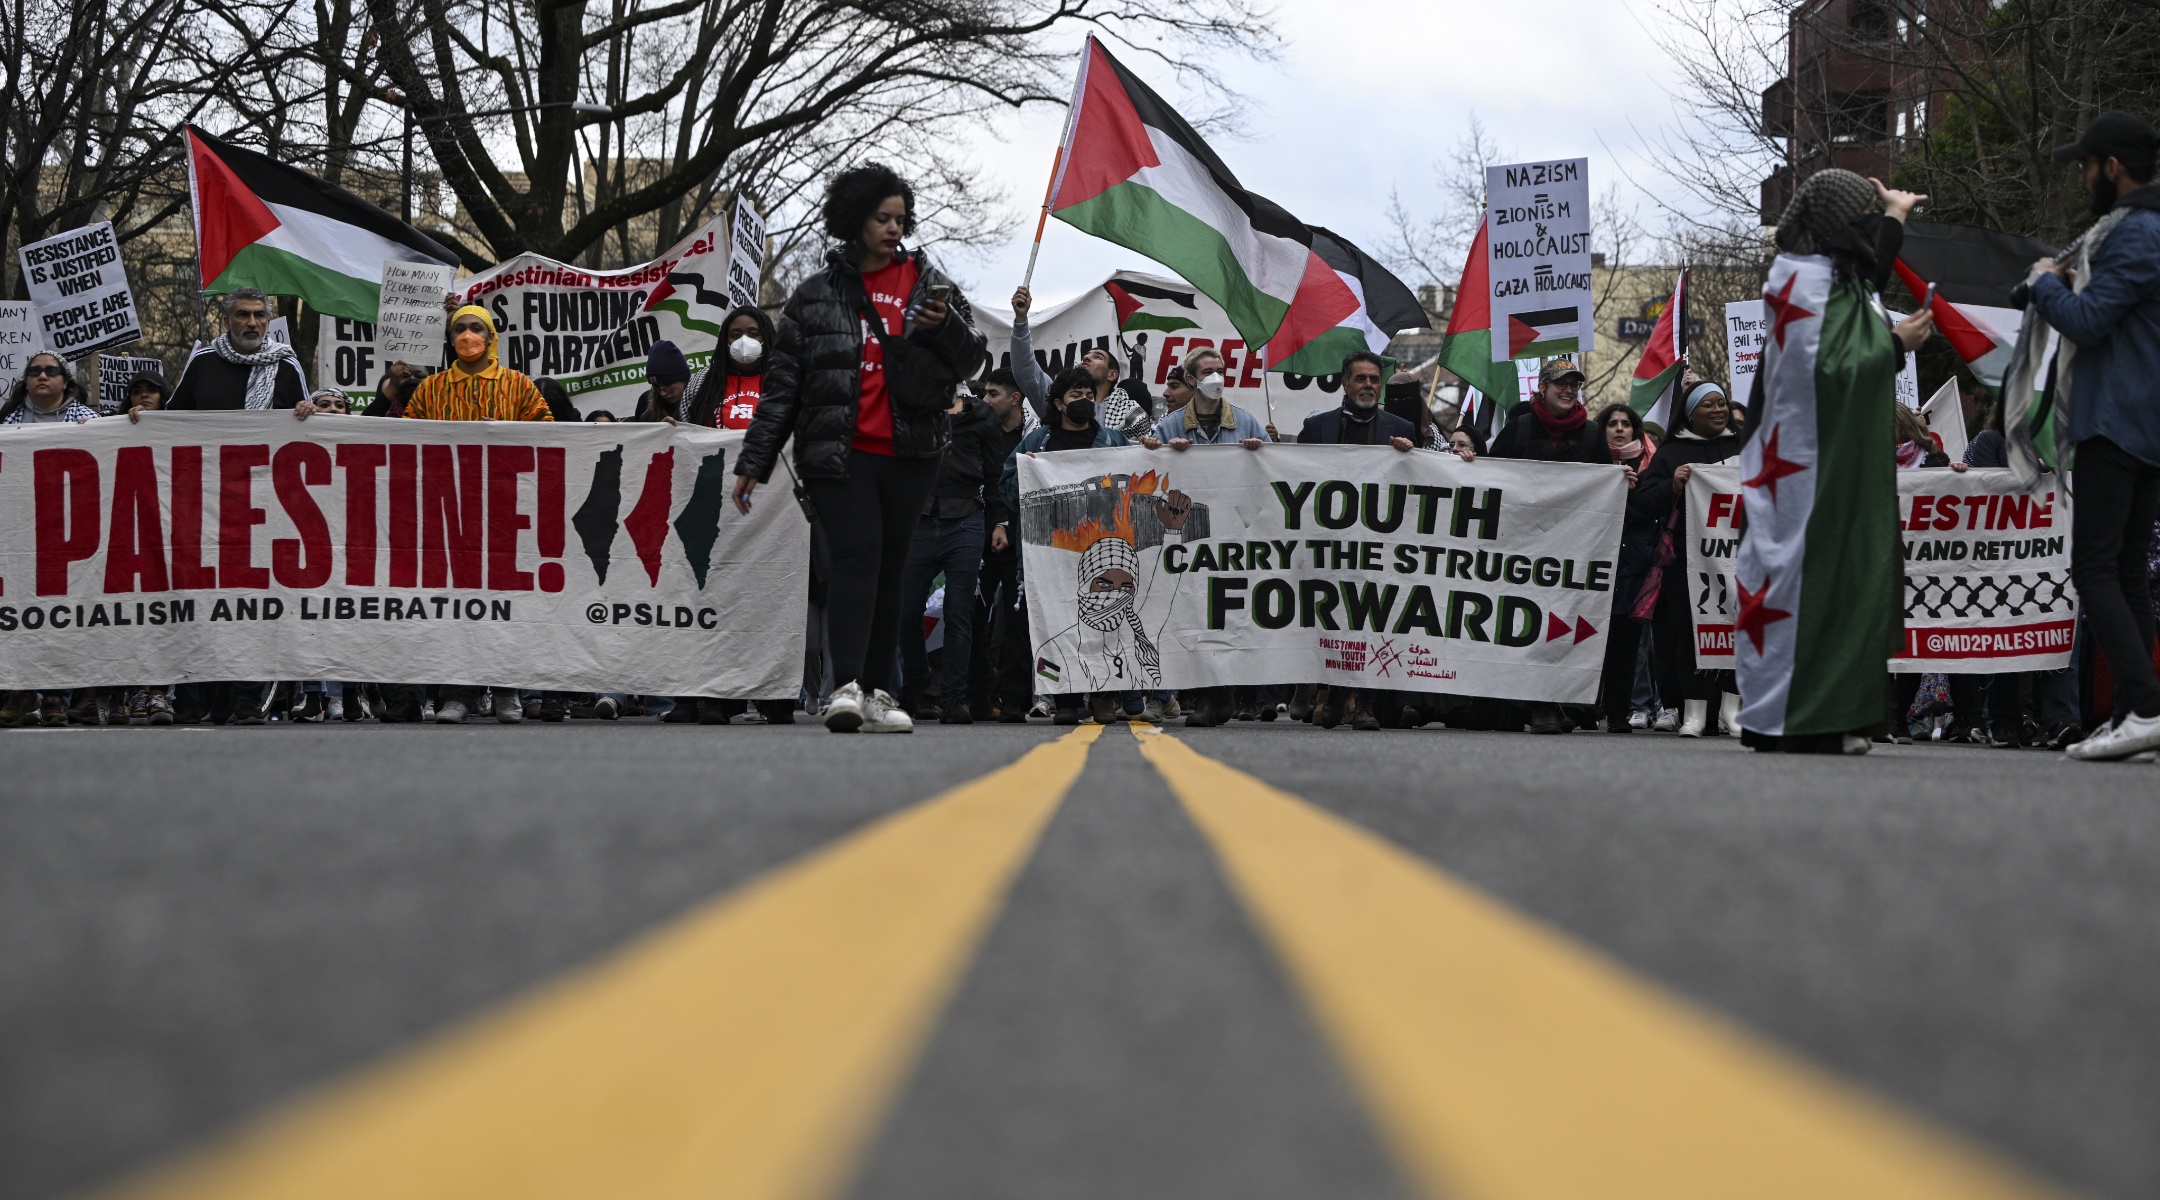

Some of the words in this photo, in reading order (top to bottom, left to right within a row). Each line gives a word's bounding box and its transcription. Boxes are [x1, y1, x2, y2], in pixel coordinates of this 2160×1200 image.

[738, 203, 754, 238] FREE
[753, 222, 765, 253] ALL
[1535, 222, 1547, 237] &
[25, 226, 113, 267] RESISTANCE
[1494, 232, 1590, 259] HOLOCAUST
[30, 266, 48, 285] IS
[50, 245, 117, 280] JUSTIFIED
[386, 266, 410, 277] HOW
[410, 270, 440, 283] MANY
[56, 270, 103, 297] WHEN
[384, 279, 421, 295] PEOPLE
[420, 285, 446, 296] MUST
[466, 266, 592, 303] Palestinian
[729, 258, 758, 304] POLITICAL
[1494, 278, 1529, 298] GAZA
[1535, 272, 1592, 292] HOLOCAUST
[42, 301, 101, 332] PEOPLE
[102, 290, 131, 315] ARE
[382, 294, 400, 306] SET
[53, 311, 131, 349] OCCUPIED!
[383, 311, 398, 322] ON
[399, 312, 424, 325] FIRE
[424, 315, 442, 326] FOR
[1728, 316, 1757, 332] There
[1759, 319, 1767, 330] is
[381, 325, 404, 338] YALL
[407, 330, 423, 340] TO
[508, 315, 661, 376] APARTHEID
[1733, 333, 1750, 348] evil
[384, 339, 409, 352] GET
[408, 343, 429, 355] IT?
[99, 356, 129, 372] STAND
[131, 359, 160, 372] WITH
[335, 345, 375, 387] OF
[566, 366, 648, 394] IBERATION
[33, 440, 566, 597] PALESTINE!
[1270, 480, 1503, 541] YOUTH
[1915, 539, 1969, 562] AND
[1971, 535, 2065, 561] RETURN
[1163, 540, 1299, 575] CARRY
[1305, 539, 1384, 572] THE
[1393, 543, 1613, 592] STRUGGLE
[0, 599, 196, 631] SOCIALISM
[209, 597, 285, 622] AND
[300, 596, 512, 622] LIBERATION
[586, 602, 718, 630] @PSLDC
[1207, 576, 1543, 648] FORWARD
[1319, 637, 1367, 652] PALESTINIAN
[1926, 627, 2072, 653] @MD2PALESTINE
[1325, 658, 1366, 672] MOVEMENT
[1340, 650, 1366, 662] YOUTH
